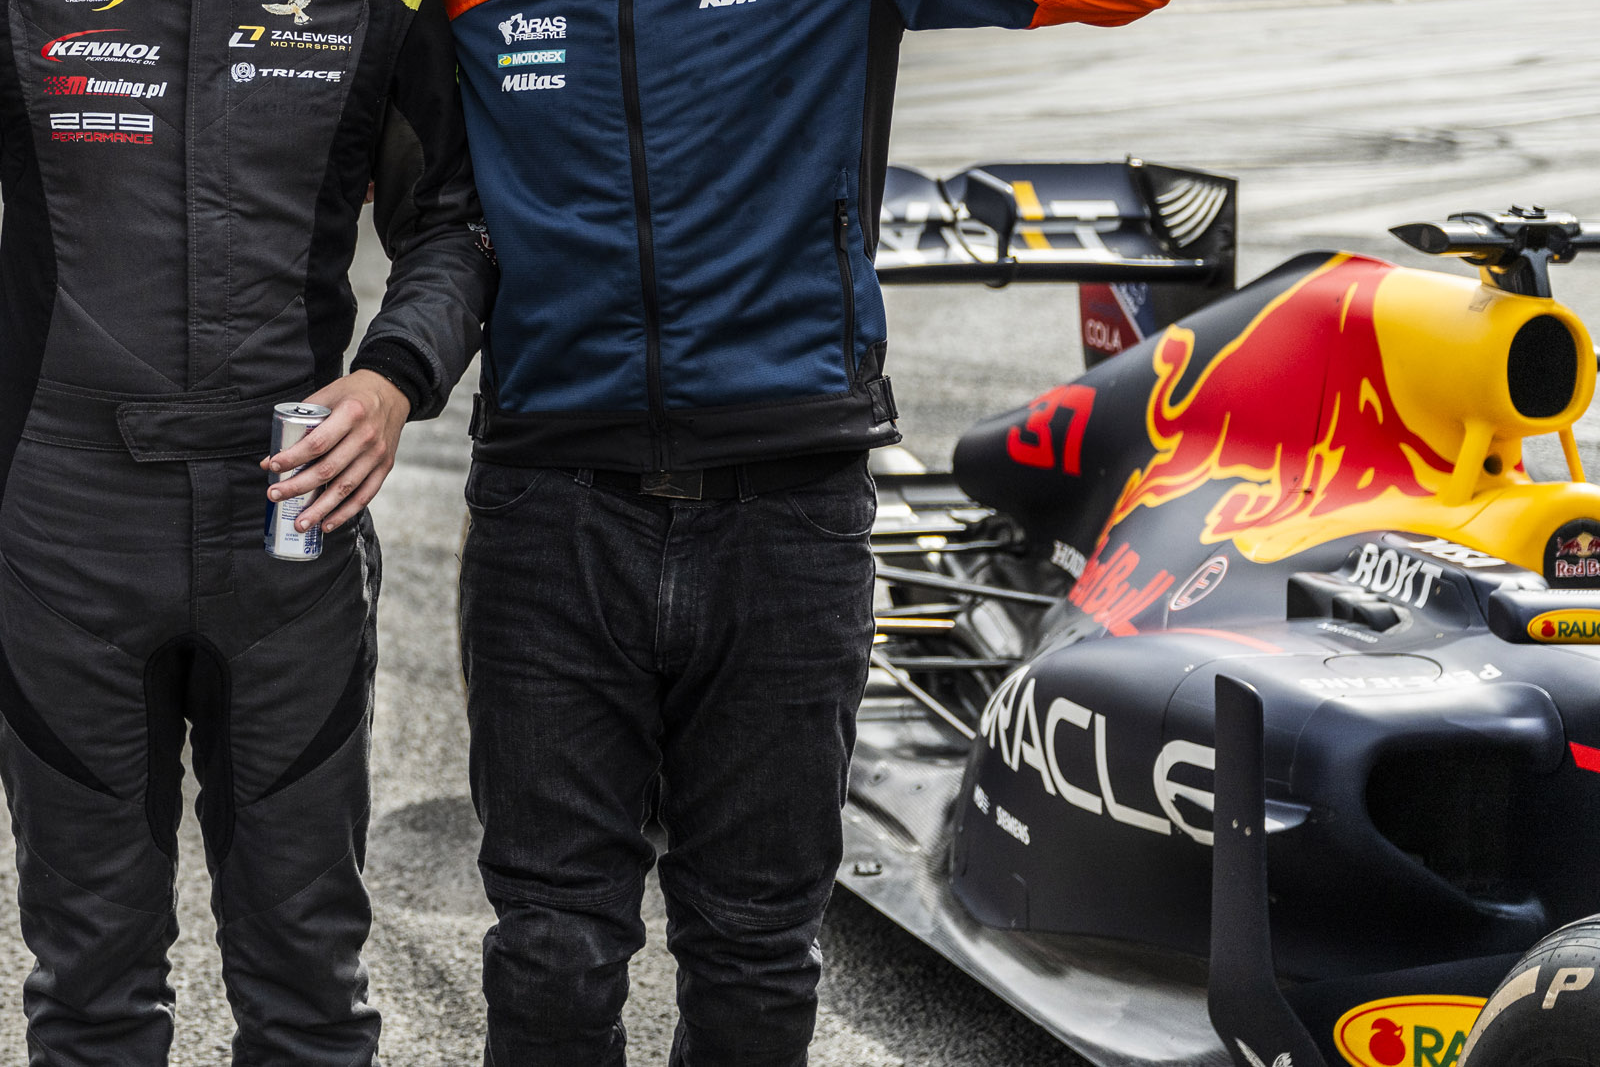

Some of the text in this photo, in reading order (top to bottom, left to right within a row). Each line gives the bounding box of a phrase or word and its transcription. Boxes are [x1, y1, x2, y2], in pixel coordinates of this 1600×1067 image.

[516, 16, 567, 34] ARAS
[271, 30, 352, 44] ZALEWSKI
[513, 30, 567, 42] FREESTYLE
[47, 41, 161, 61] KENNOL
[512, 51, 563, 65] MOTOREX
[85, 56, 156, 66] PERFORMANCE OIL
[258, 68, 341, 79] TRI-ACE
[501, 73, 566, 92] Mitas
[50, 112, 154, 132] 229
[51, 131, 154, 144] PERFORMANCE
[1006, 383, 1097, 477] 37
[1347, 542, 1444, 609] ROKT
[1555, 559, 1586, 577] Red
